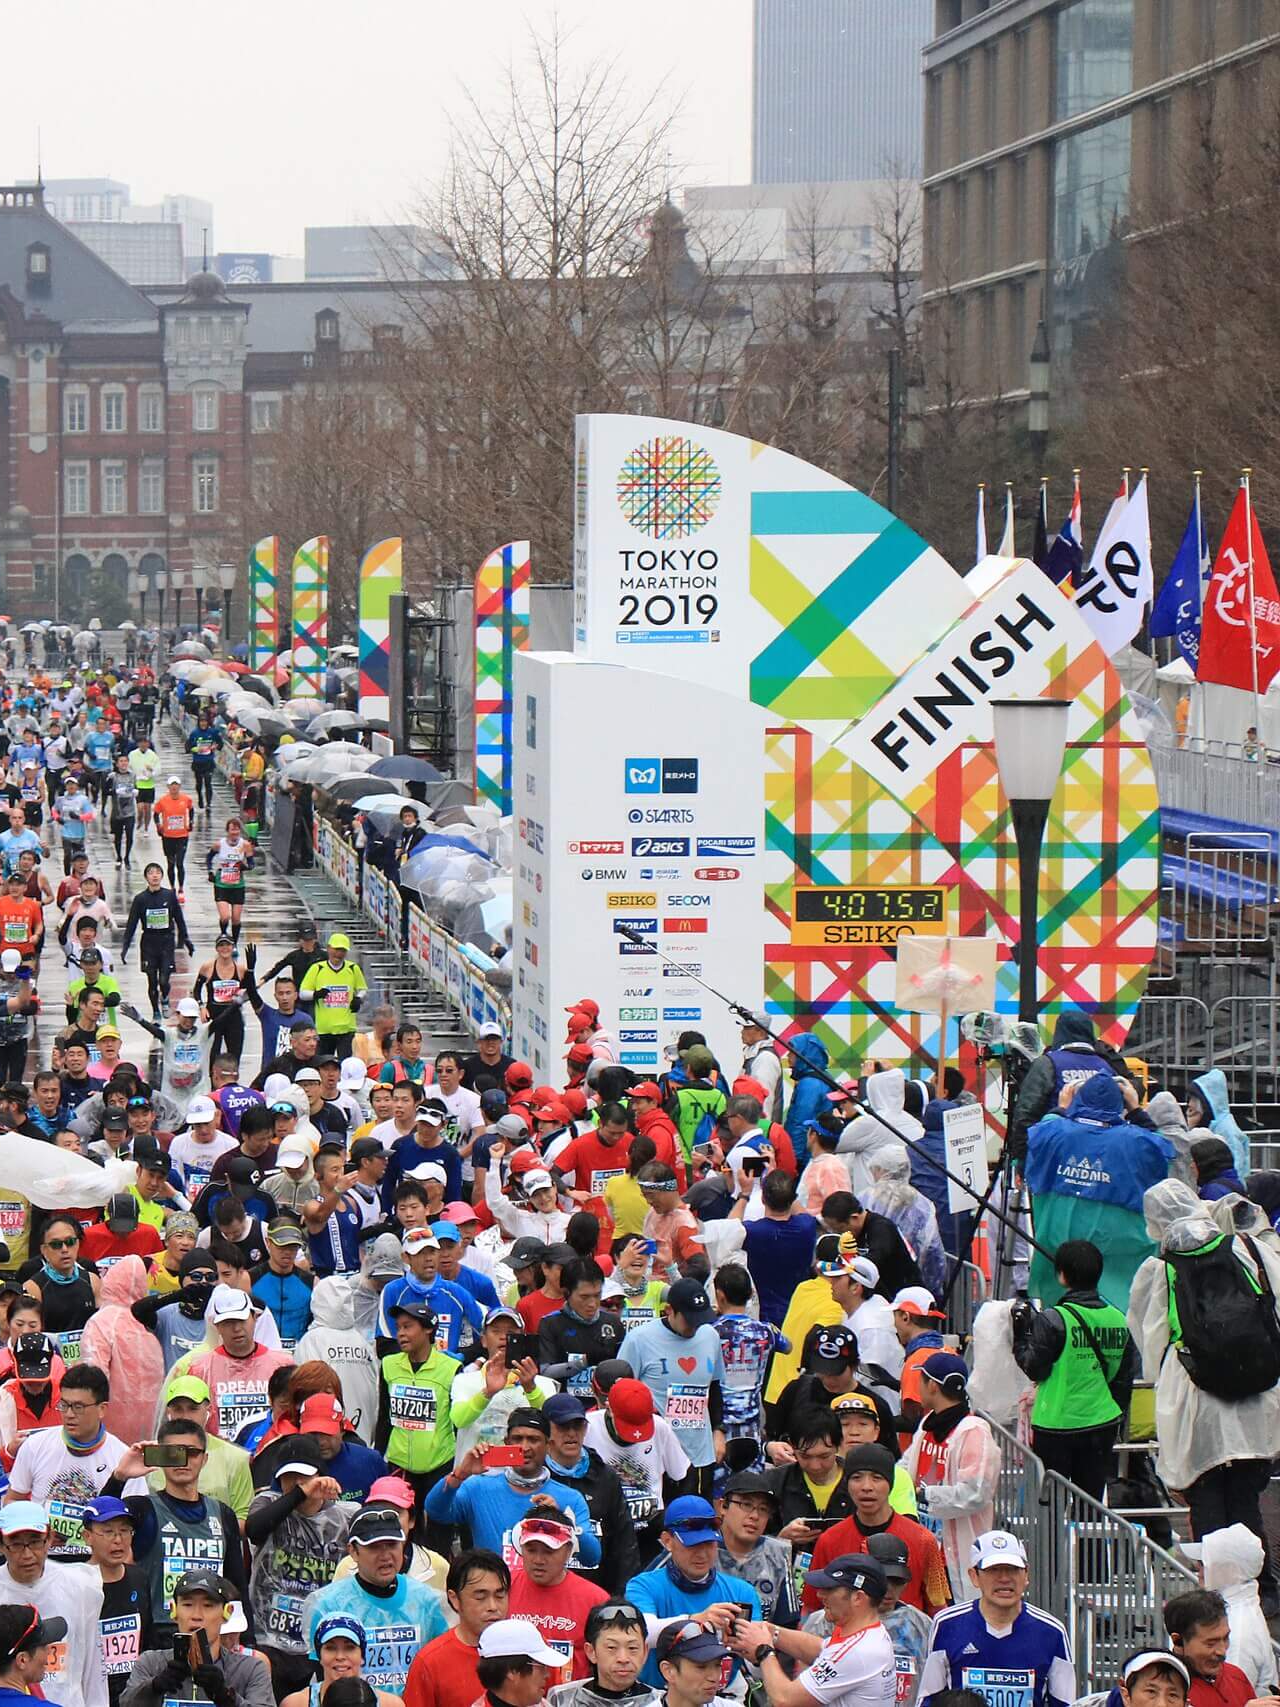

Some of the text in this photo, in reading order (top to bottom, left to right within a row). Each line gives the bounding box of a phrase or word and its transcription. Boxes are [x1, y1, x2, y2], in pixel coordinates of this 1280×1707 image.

[619, 550, 718, 571] TOKYO
[619, 577, 717, 589] MARATHON
[619, 594, 718, 627] 2019
[870, 593, 1057, 772] FINISH
[596, 870, 627, 880] BMW
[609, 896, 657, 906] SEIKO
[668, 896, 711, 905] SECOM
[103, 1621, 136, 1632] 東京メトロ
[986, 1674, 1027, 1683] 東京メトロ
